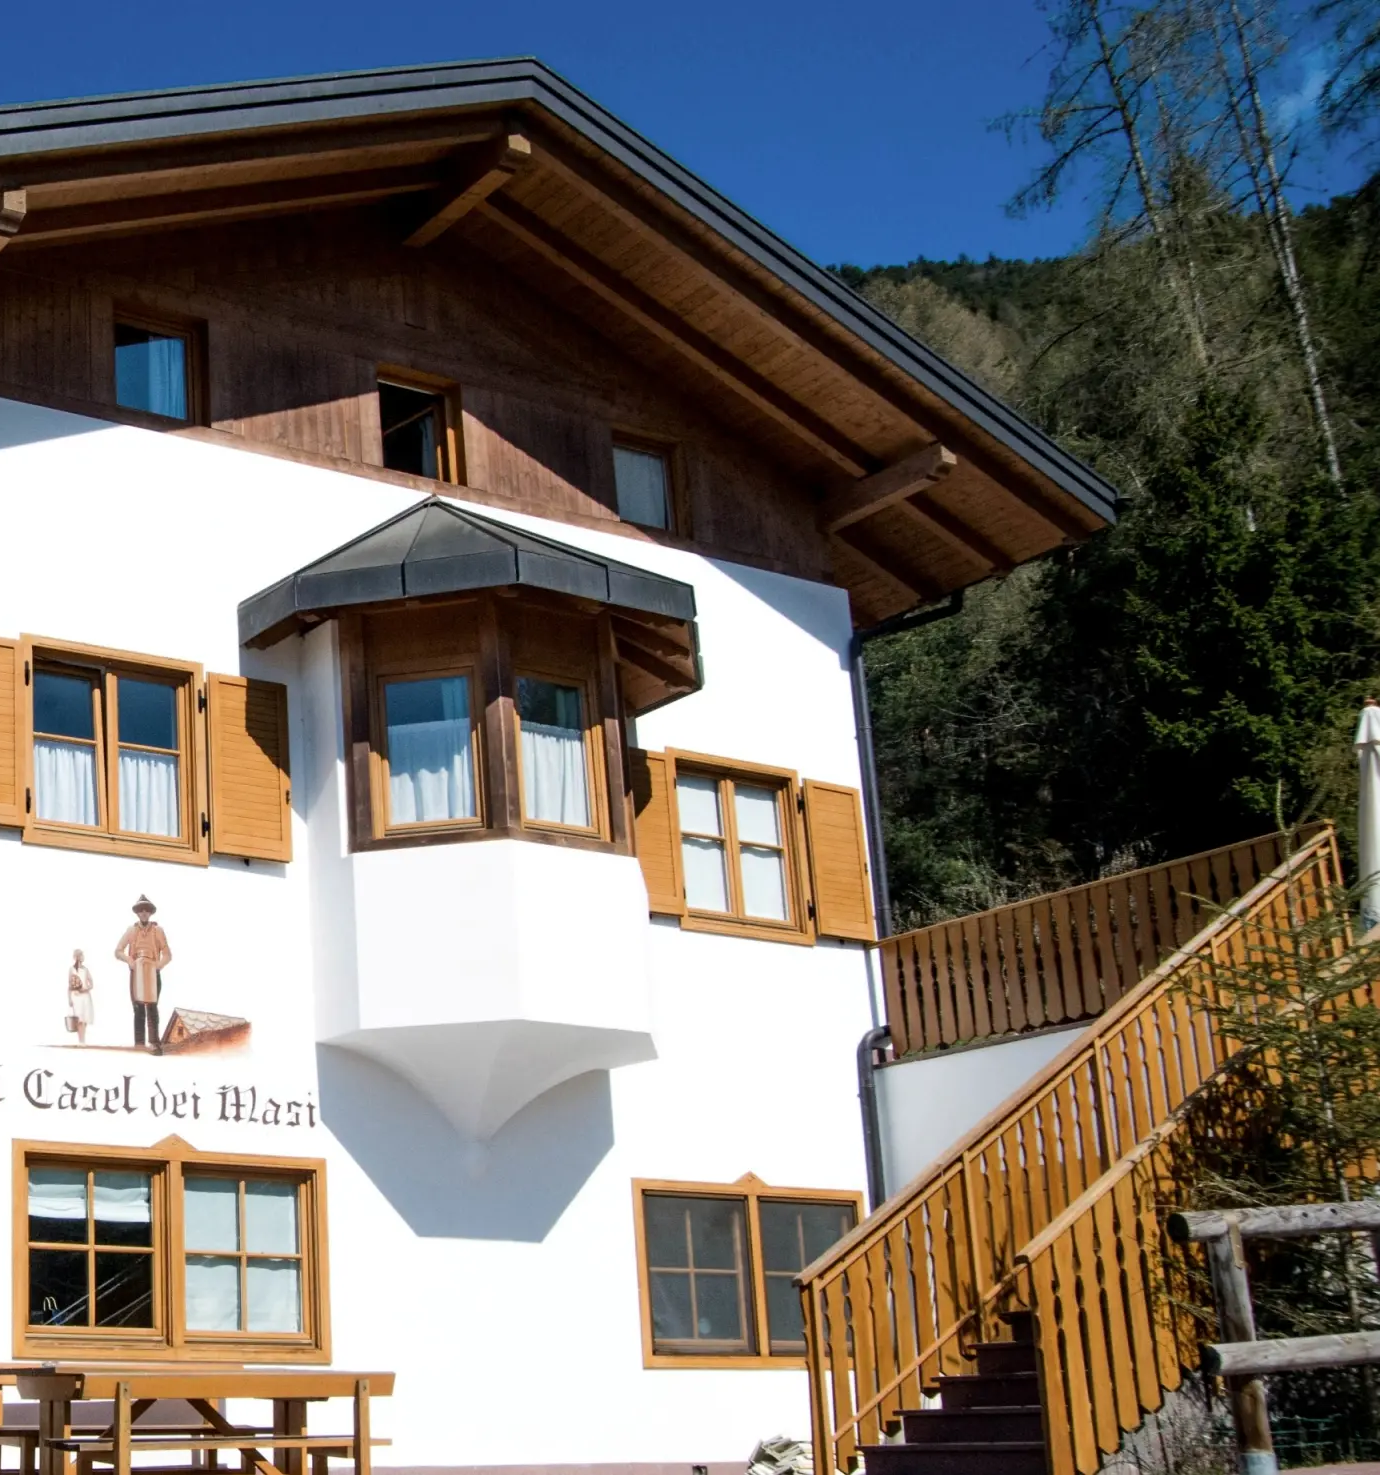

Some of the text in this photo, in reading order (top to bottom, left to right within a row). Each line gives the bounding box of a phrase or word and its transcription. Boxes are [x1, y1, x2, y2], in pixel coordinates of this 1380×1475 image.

[22, 1068, 138, 1115] Casel
[149, 1080, 201, 1120] dei
[216, 1083, 317, 1129] Masi
